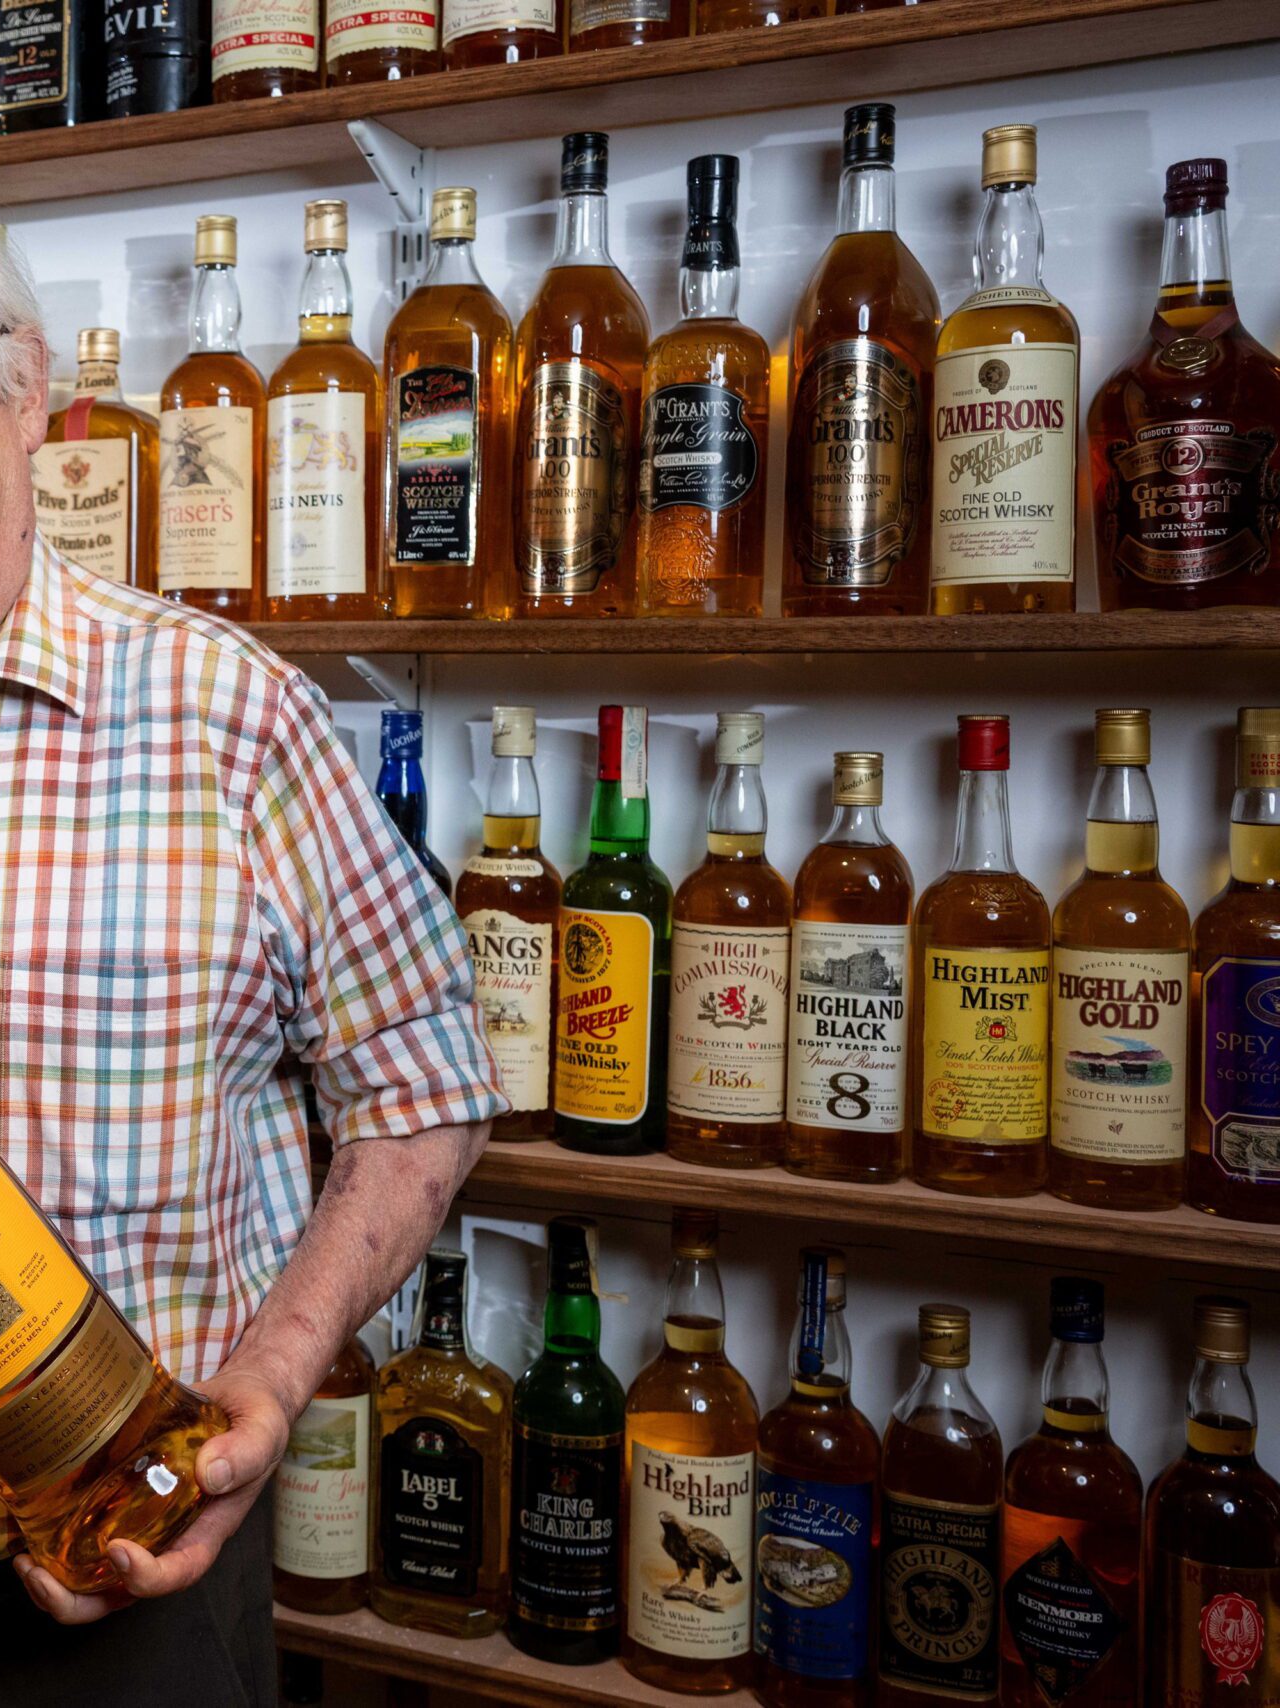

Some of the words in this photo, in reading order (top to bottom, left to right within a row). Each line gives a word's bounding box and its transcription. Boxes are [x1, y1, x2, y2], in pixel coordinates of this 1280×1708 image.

[105, 5, 177, 42] EVIL
[330, 16, 365, 34] EXTRA
[370, 12, 425, 23] SPECIAL
[252, 33, 305, 45] SPECIAL
[18, 45, 38, 66] 12
[952, 389, 974, 397] PRODUCE
[666, 397, 730, 419] GRANT'S
[937, 399, 1064, 438] CAMERONS
[684, 416, 748, 449] Grain
[809, 411, 896, 444] Grant's
[1140, 426, 1172, 440] PRODUCT
[1174, 425, 1186, 434] OF
[1188, 424, 1230, 434] SCOTLAND
[656, 455, 683, 465] SCOTCH
[685, 453, 718, 464] WHISKY
[948, 432, 1009, 485] SPECIAL
[973, 433, 1044, 487] RESERVE
[411, 475, 458, 483] RESERVE
[843, 471, 891, 487] STRENGTH
[1132, 478, 1242, 501] Grant's
[297, 494, 344, 508] NEVIS
[402, 485, 465, 498] SCOTCH
[553, 487, 598, 499] STRENGTH
[845, 488, 884, 504] WHISKY
[962, 493, 990, 505] FINE
[993, 491, 1022, 504] OLD
[405, 497, 461, 510] WHISKY
[939, 505, 989, 523] SCOTCH
[994, 504, 1055, 519] WHISKY
[1138, 496, 1231, 520] Royal
[166, 525, 217, 540] Supreme
[1142, 529, 1178, 540] SCOTCH
[1181, 528, 1228, 538] WHISKY
[1160, 522, 1206, 531] FINEST
[505, 862, 538, 872] WHISKY
[470, 932, 544, 960] ANGS
[583, 915, 613, 956] SCOTLAND
[713, 941, 757, 959] HIGH
[474, 961, 543, 977] PREME
[932, 956, 1048, 984] HIGHLAND
[1079, 961, 1124, 972] SPECIAL
[1129, 962, 1163, 976] BLEND
[489, 976, 535, 995] Whisky
[1058, 972, 1182, 1006] HIGHLAND
[796, 993, 904, 1020] HIGHLAND
[960, 985, 1029, 1011] MIST
[567, 1003, 634, 1040] BREEZE
[1078, 1000, 1160, 1030] GOLD
[815, 1018, 887, 1041] BLACK
[992, 1027, 1004, 1036] HM
[584, 1042, 619, 1055] OLD
[675, 1033, 694, 1045] OLD
[695, 1036, 743, 1050] SCOTCH
[797, 1038, 832, 1049] EIGHT
[838, 1042, 878, 1053] YEARS
[882, 1045, 902, 1053] OLD
[935, 1041, 973, 1062] Finest
[979, 1045, 1016, 1063] Scotch
[1215, 1032, 1275, 1055] SPEY
[577, 1054, 631, 1079] Whisky
[801, 1047, 848, 1068] Special
[849, 1051, 896, 1071] Reserve
[968, 1063, 1004, 1071] SCOTCH
[708, 1068, 752, 1089] 1856
[797, 1097, 822, 1106] AGED
[826, 1072, 871, 1120] 8
[1066, 1087, 1116, 1103] SCOTCH
[1120, 1093, 1170, 1105] WHISKY
[26, 1325, 43, 1344] MEN
[50, 1299, 64, 1319] TAIN
[31, 1365, 71, 1402] YEARS
[61, 1388, 109, 1439] GLENMORANGIE
[676, 1458, 689, 1466] and
[690, 1457, 715, 1468] Bottled
[400, 1469, 464, 1502] LABEL
[642, 1462, 750, 1501] Highland
[422, 1494, 439, 1511] 5
[536, 1493, 594, 1518] KING
[687, 1497, 733, 1518] Bird
[756, 1490, 799, 1513] LOCH
[804, 1495, 862, 1536] FYNE
[313, 1510, 361, 1522] WHISKY
[395, 1512, 430, 1529] SCOTCH
[430, 1520, 465, 1535] WHISKY
[520, 1508, 613, 1541] CHARLES
[890, 1513, 932, 1533] EXTRA
[935, 1520, 988, 1540] SPECIAL
[521, 1535, 562, 1555] SCOTCH
[564, 1544, 611, 1557] WHISKY
[401, 1559, 428, 1574] Classic
[429, 1564, 458, 1580] Black
[885, 1548, 993, 1599] HIGHLAND
[641, 1591, 665, 1608] Rare
[1060, 1584, 1093, 1596] SCOTLAND
[641, 1602, 666, 1618] Scotch
[668, 1610, 701, 1624] Whisky
[1017, 1592, 1104, 1624] KENMORE
[1025, 1616, 1055, 1634] SCOTCH
[1057, 1626, 1091, 1640] WHISKY
[1038, 1613, 1077, 1629] BLENDED
[893, 1617, 983, 1659] PRINCE
